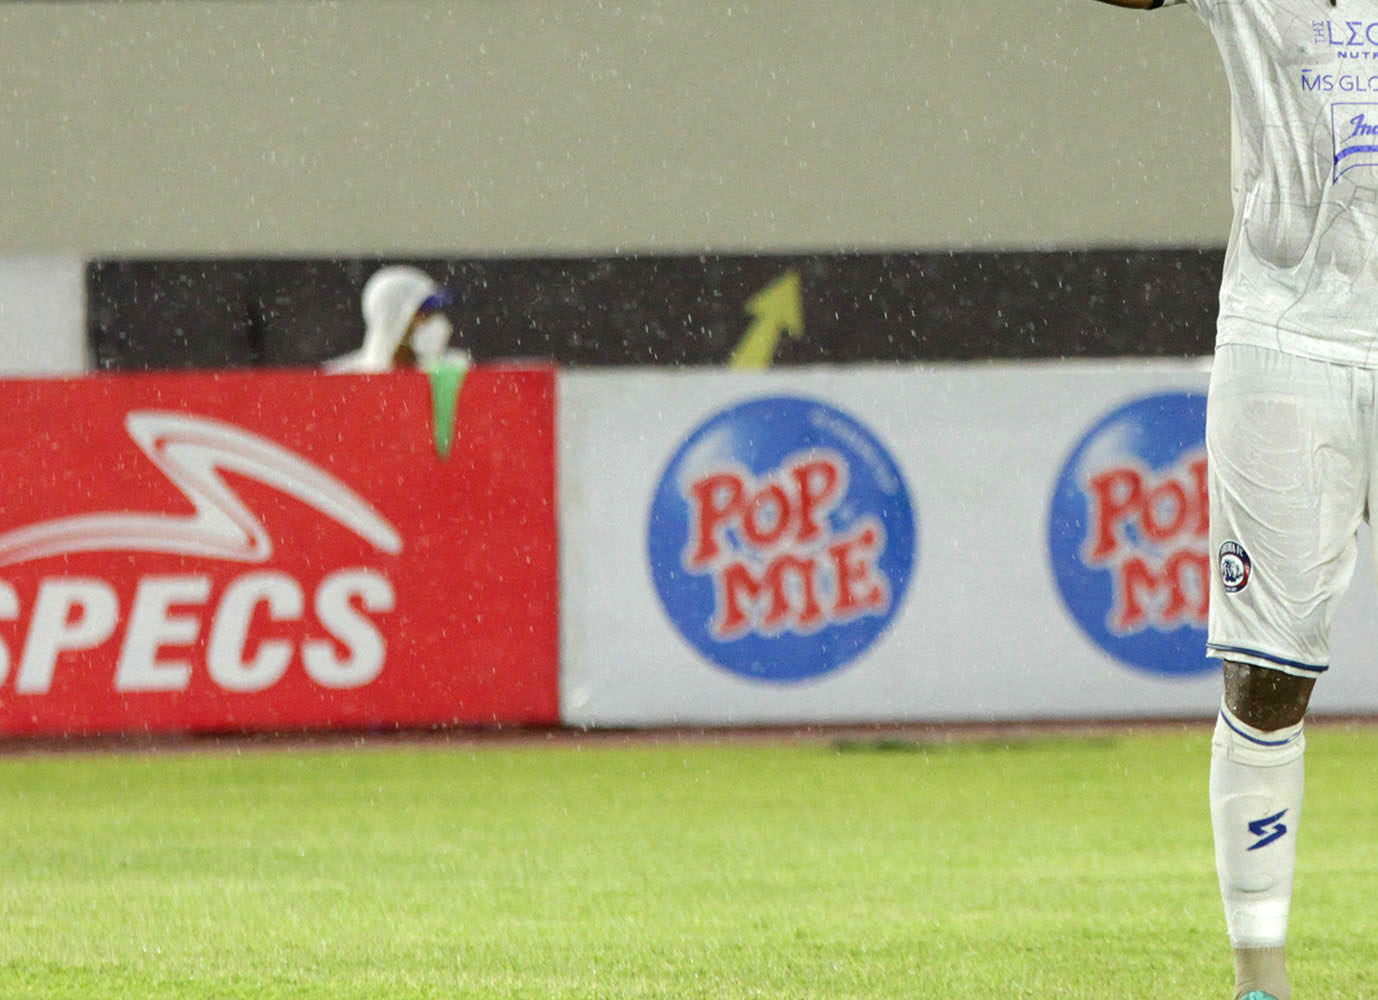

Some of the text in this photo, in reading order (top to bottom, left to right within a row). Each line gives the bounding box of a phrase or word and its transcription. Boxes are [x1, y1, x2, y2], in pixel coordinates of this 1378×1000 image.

[1301, 69, 1334, 92] MS
[690, 457, 841, 567] POP
[0, 567, 397, 695] PECS
[714, 526, 886, 639] MIE
